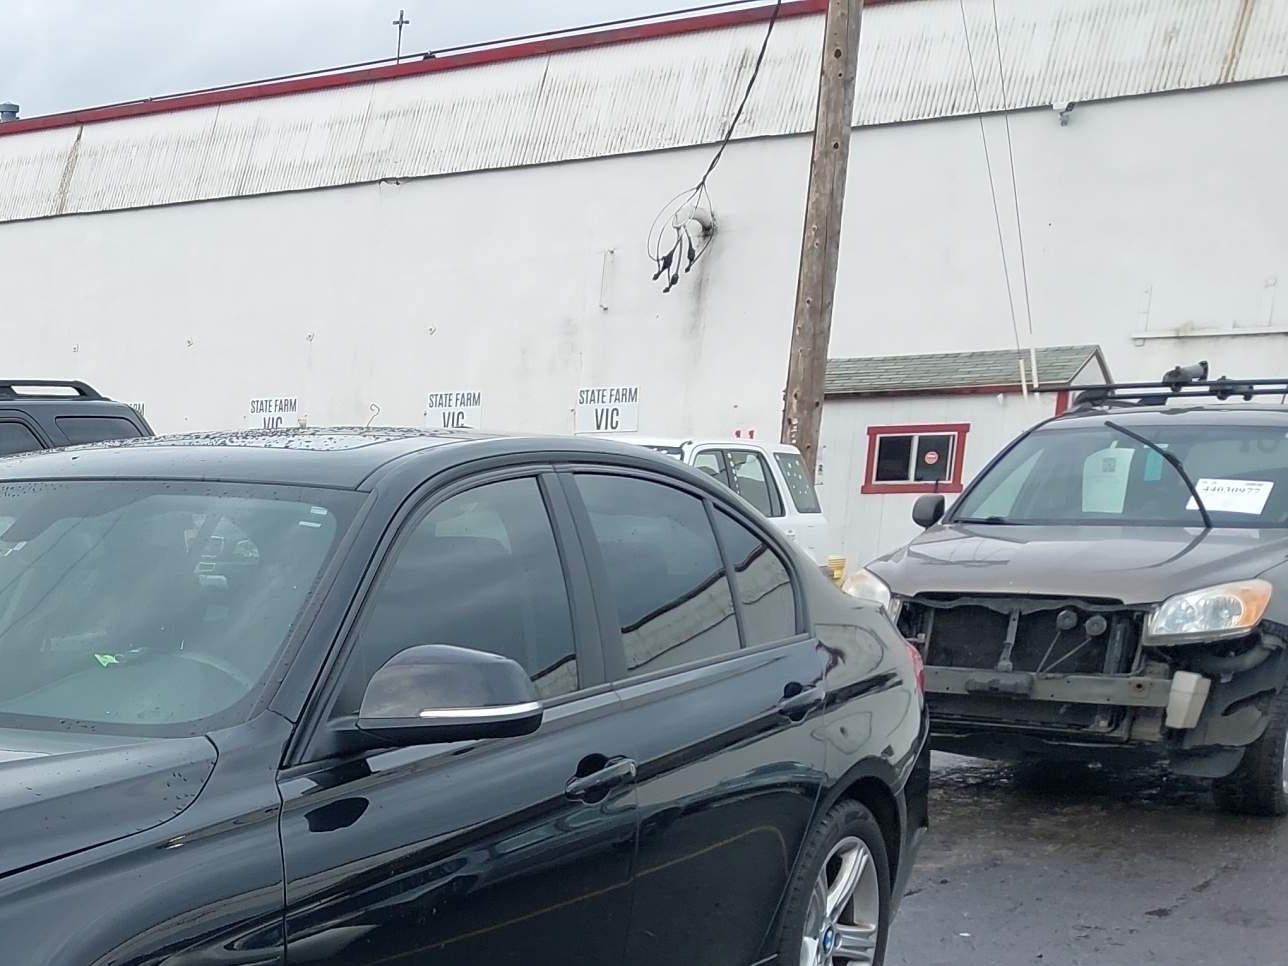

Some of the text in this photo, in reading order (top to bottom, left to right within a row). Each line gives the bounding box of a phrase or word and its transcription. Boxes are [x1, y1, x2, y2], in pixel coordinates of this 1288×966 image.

[428, 392, 481, 408] STATE FARM
[578, 387, 638, 404] STATE FARM
[250, 398, 297, 414] STATE FARM
[263, 416, 283, 429] VIC
[442, 411, 465, 428] VIC
[594, 408, 620, 430] VIC
